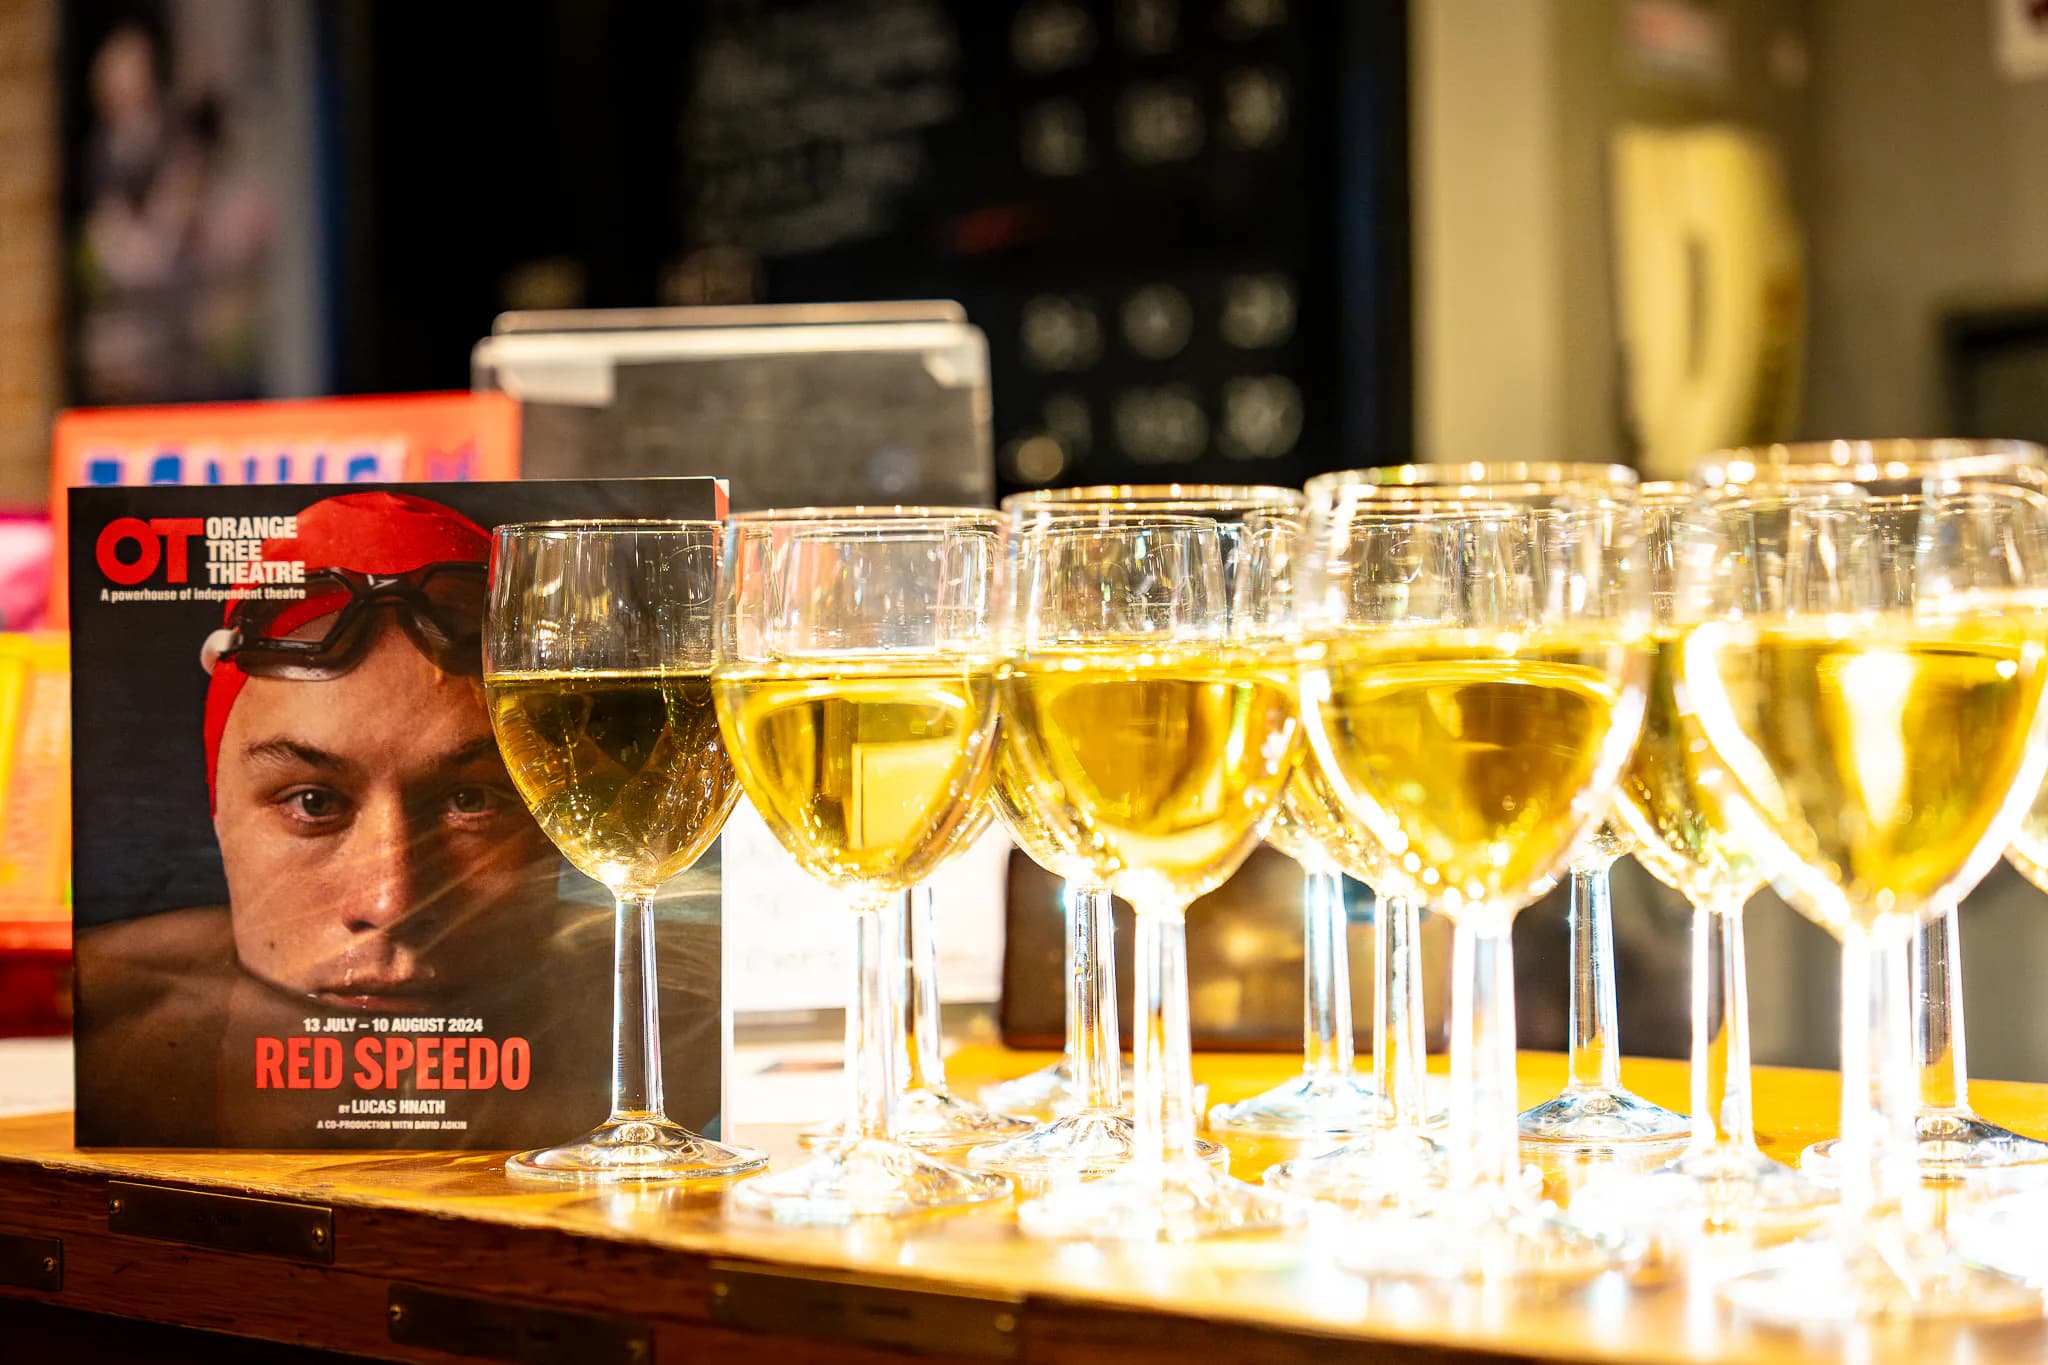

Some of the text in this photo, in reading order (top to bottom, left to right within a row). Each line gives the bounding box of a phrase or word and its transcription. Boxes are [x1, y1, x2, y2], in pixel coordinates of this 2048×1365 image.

[206, 516, 298, 539] ORANGE
[96, 516, 204, 585] OT
[206, 540, 262, 561] TREE
[206, 561, 306, 584] THEATRE
[101, 588, 306, 604] A powerhouse of independent theatre
[303, 1018, 320, 1032] 13
[323, 1018, 357, 1032] JULY
[372, 1018, 389, 1032] 10
[391, 1018, 446, 1032] AUGUST
[448, 1018, 484, 1032] 2024
[255, 1036, 531, 1091] RED SPEEDO
[338, 1100, 446, 1114] BY LUCAS HNATH
[316, 1120, 324, 1129] A
[325, 1120, 391, 1130] CO-PRODUCTION
[392, 1121, 414, 1130] WITH
[414, 1121, 440, 1130] DAVID
